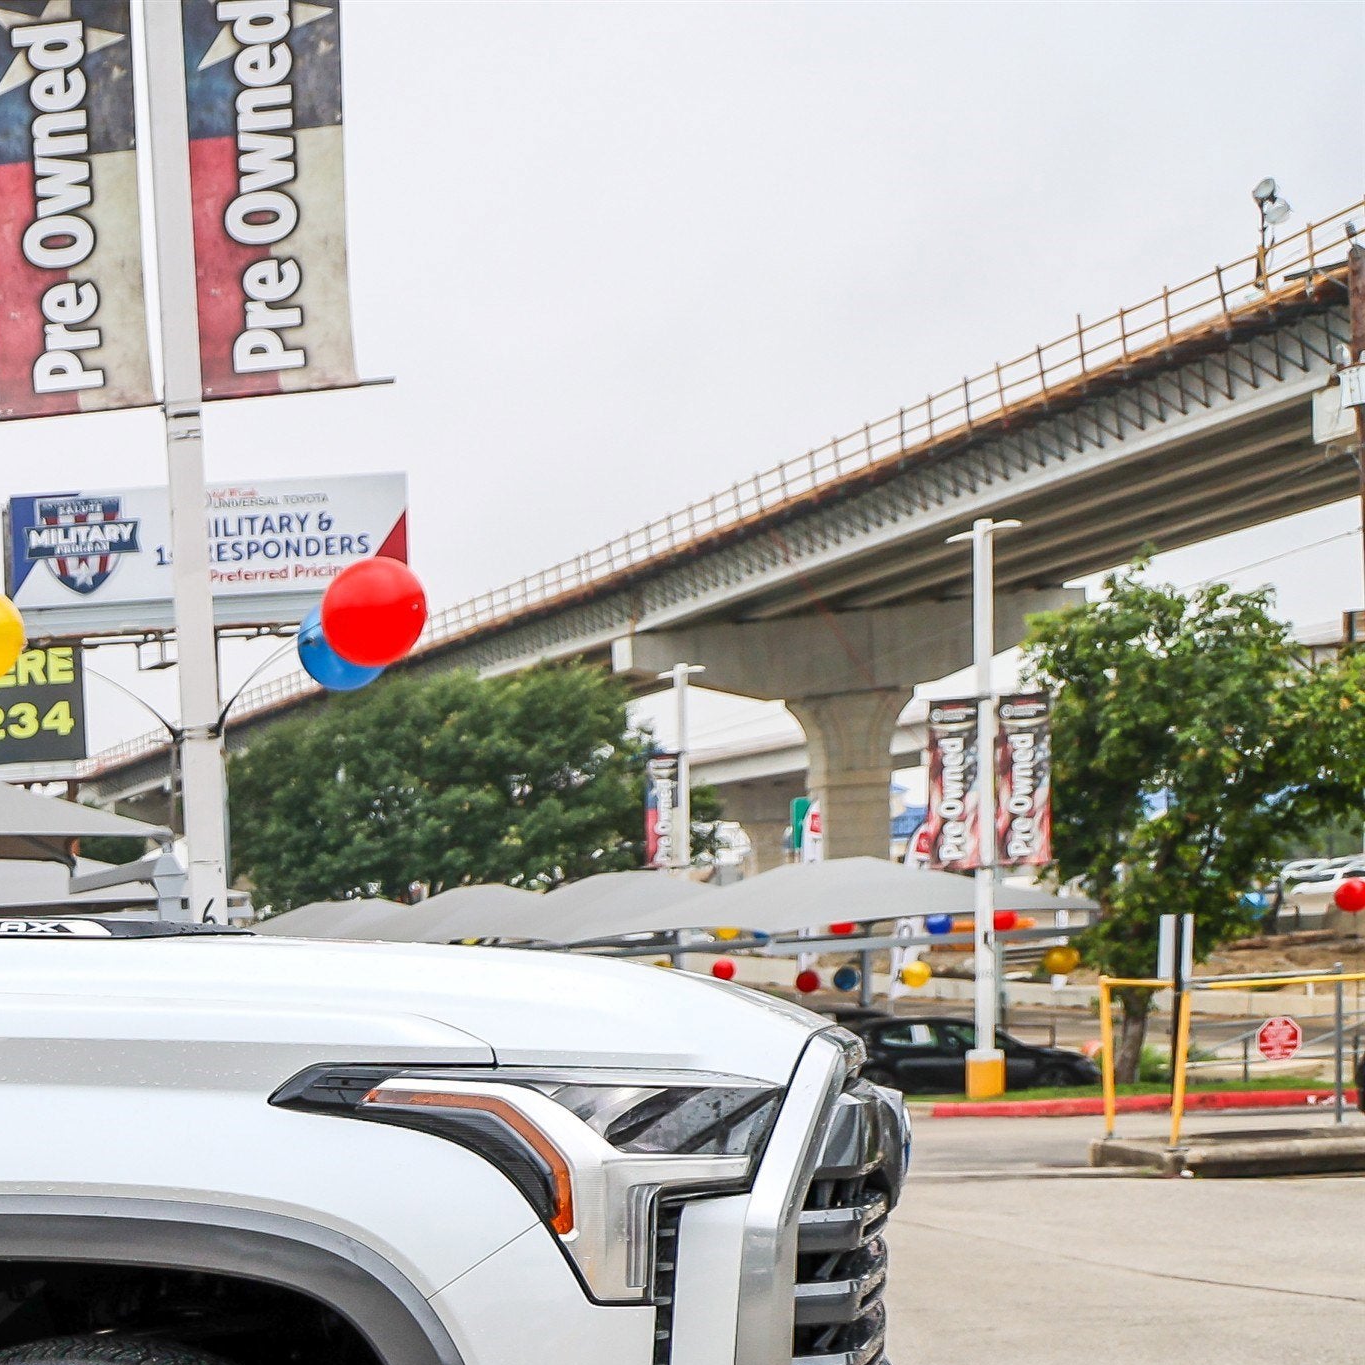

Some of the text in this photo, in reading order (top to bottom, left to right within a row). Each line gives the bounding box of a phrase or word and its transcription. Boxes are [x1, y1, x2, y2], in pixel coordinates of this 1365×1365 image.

[217, 0, 307, 374] Pre Owned
[11, 19, 106, 394] Pre Owned
[282, 492, 329, 504] TOYOTA
[29, 523, 135, 549] MILITARY
[209, 510, 334, 538] ILITARY &
[209, 533, 371, 563] ESPONDERS
[210, 562, 344, 583] Preferred Pricin
